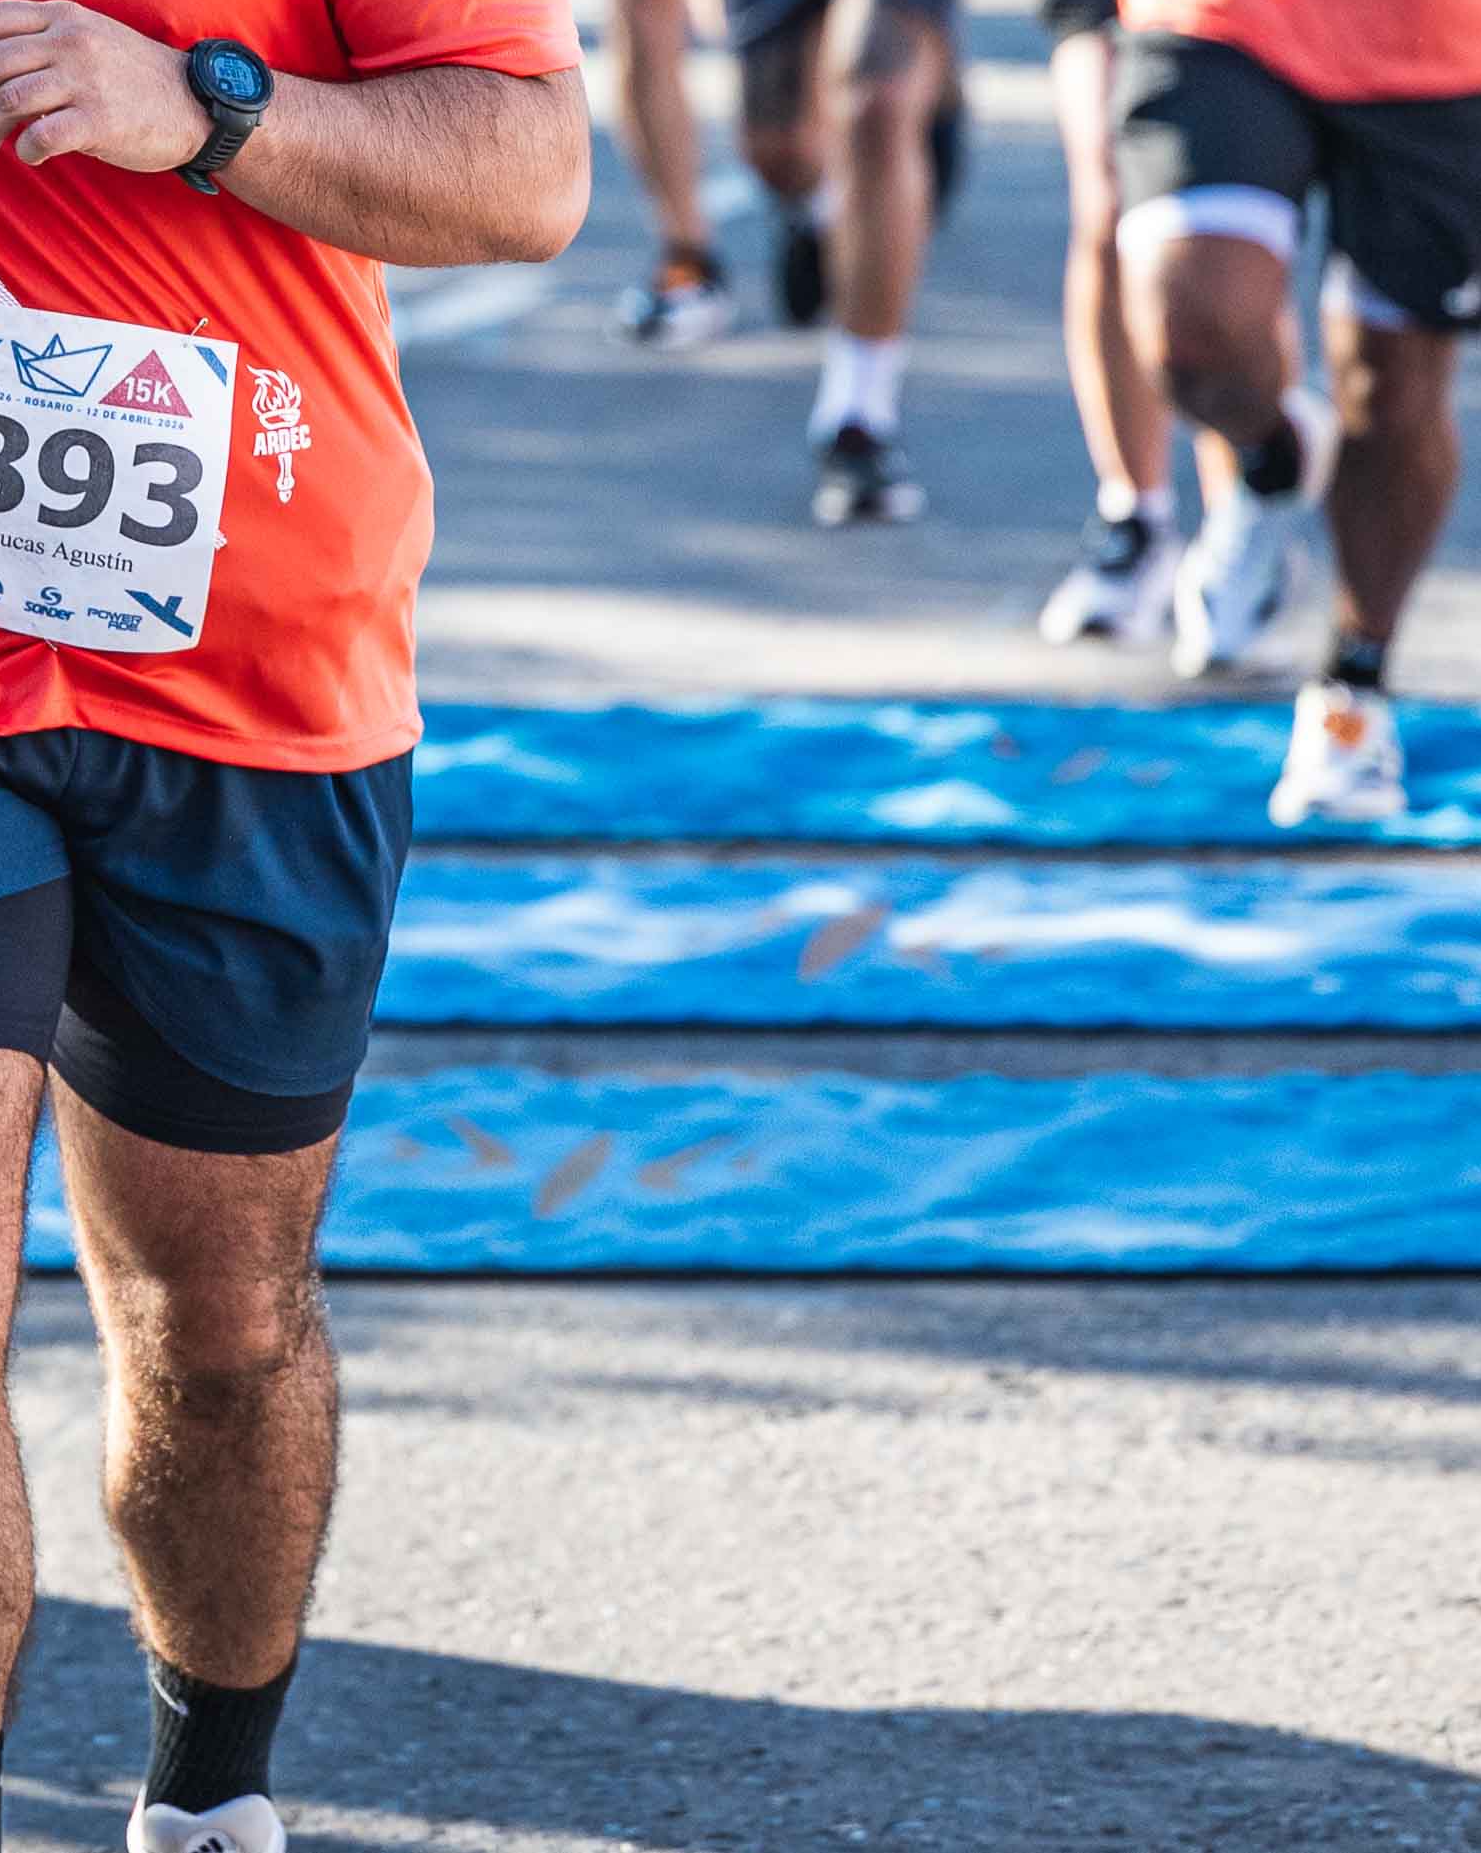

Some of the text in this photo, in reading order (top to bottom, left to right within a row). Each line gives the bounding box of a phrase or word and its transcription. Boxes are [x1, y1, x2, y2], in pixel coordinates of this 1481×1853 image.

[125, 375, 173, 407] 15K
[24, 396, 74, 413] ROSARIO
[86, 407, 98, 418] 12
[103, 410, 117, 420] DE
[121, 413, 154, 426] ABRIL
[157, 418, 185, 431] 2026
[252, 424, 312, 457] ARDEC
[51, 541, 134, 573] Agustín
[86, 606, 144, 626] POWER
